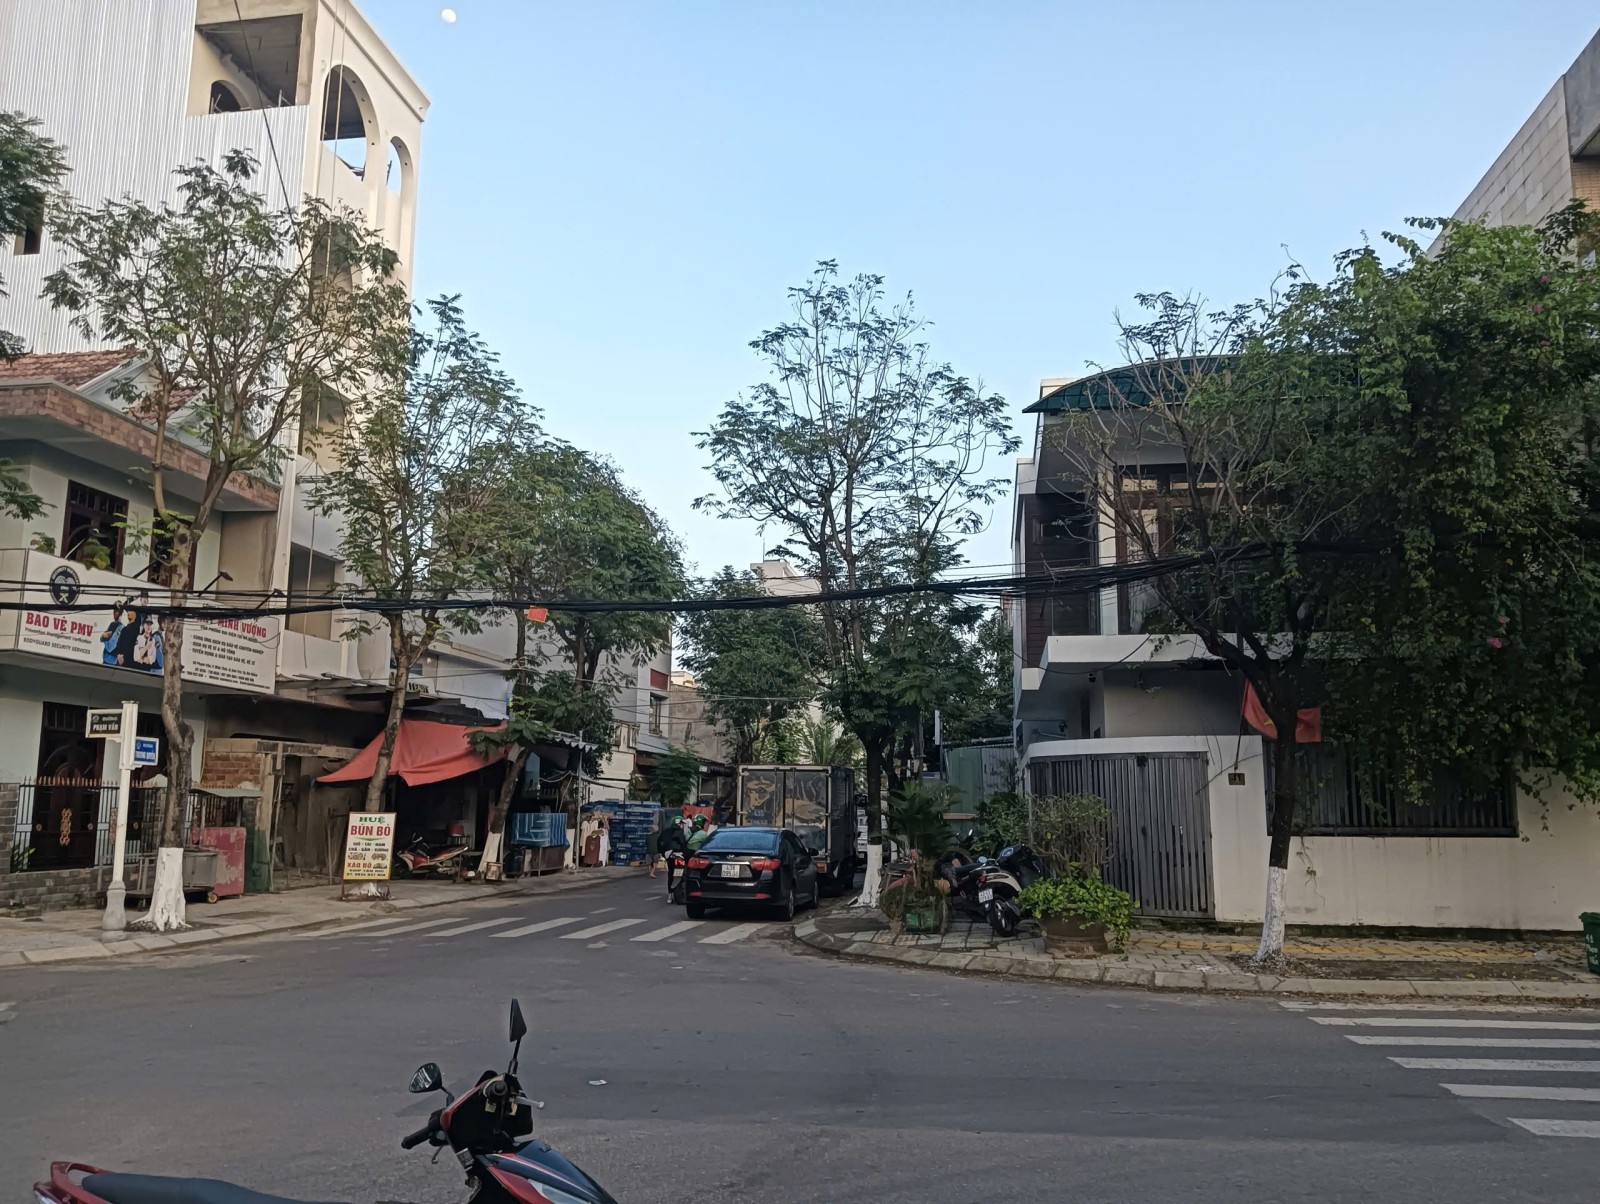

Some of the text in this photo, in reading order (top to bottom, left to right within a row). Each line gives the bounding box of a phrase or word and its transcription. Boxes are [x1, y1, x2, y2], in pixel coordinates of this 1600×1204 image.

[53, 616, 68, 635] VỆ
[70, 621, 94, 637] PMV
[23, 637, 91, 655] BODYGUARD SECURITY SERVICES
[350, 823, 391, 836] BÚN BÒ
